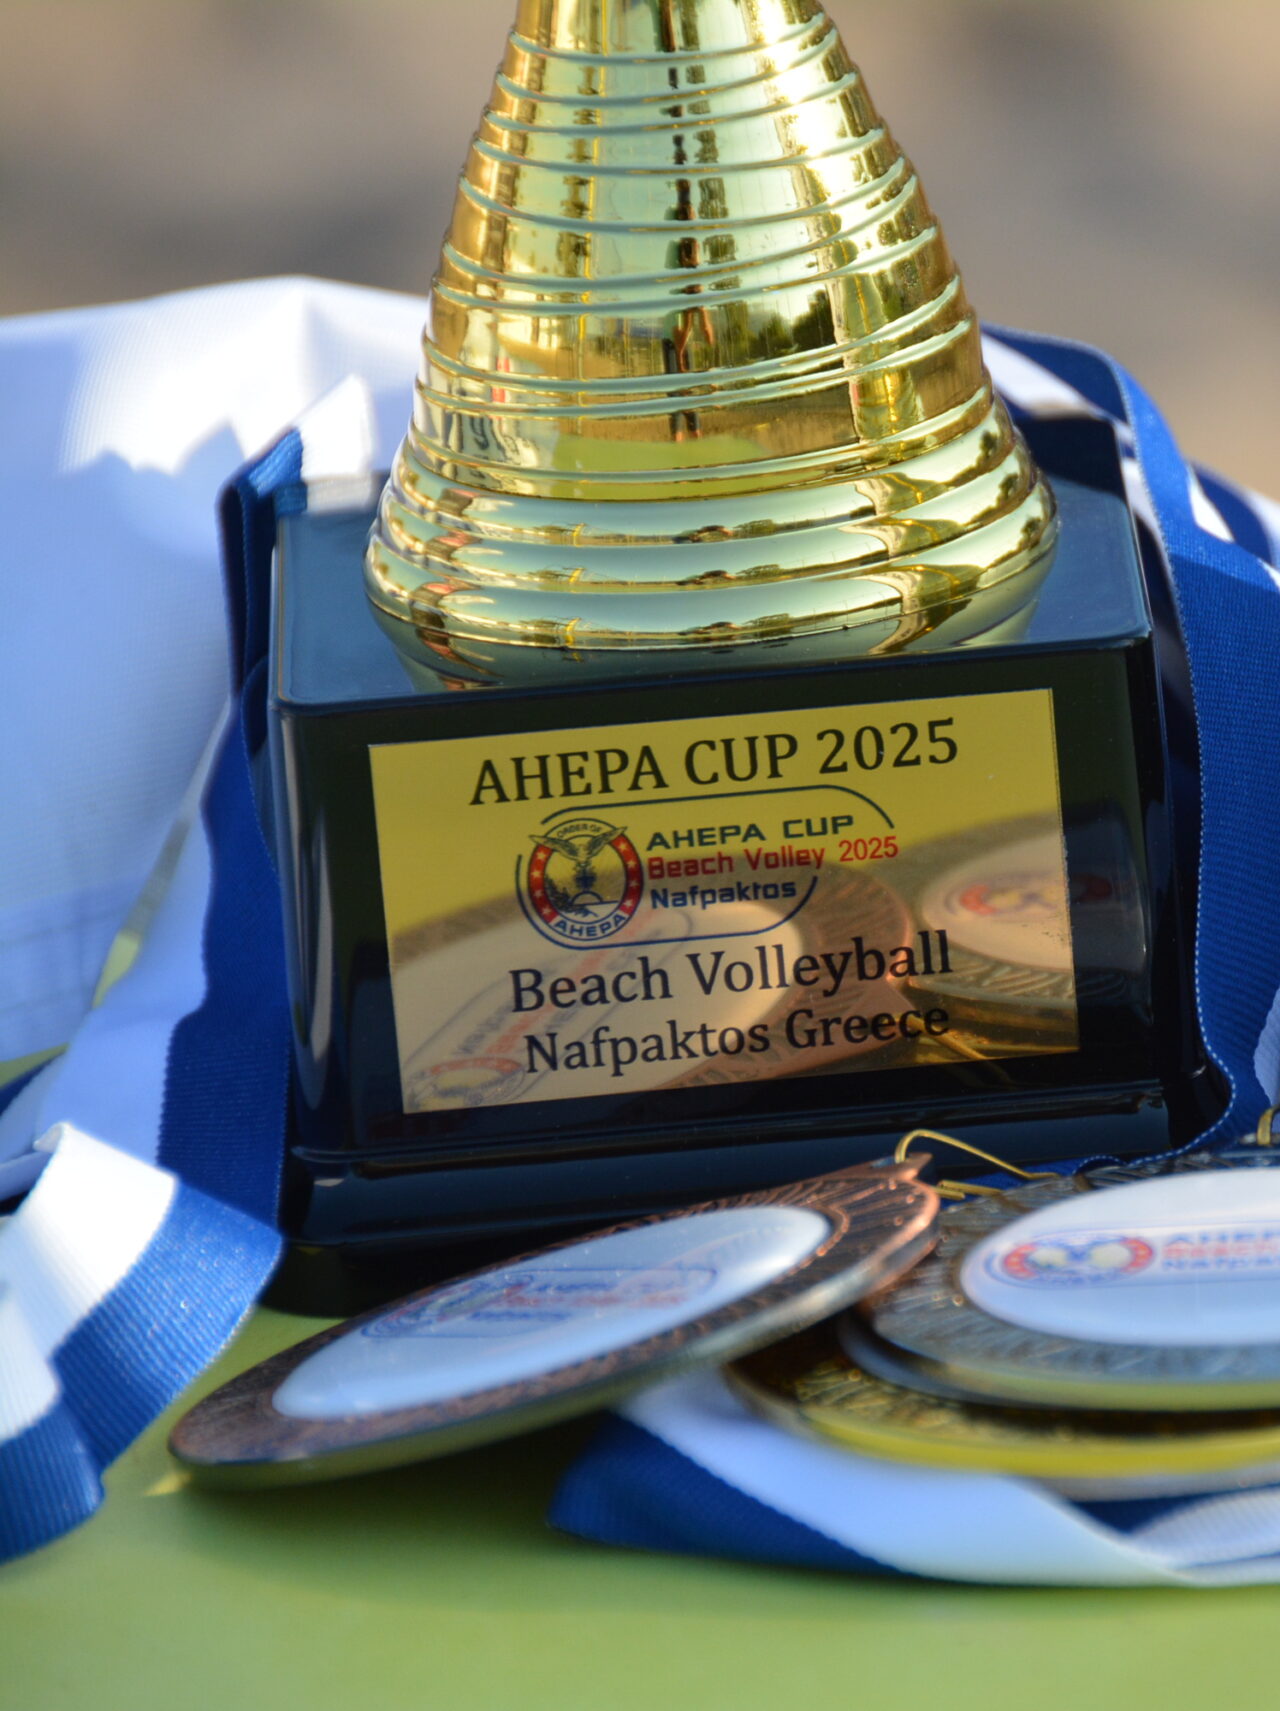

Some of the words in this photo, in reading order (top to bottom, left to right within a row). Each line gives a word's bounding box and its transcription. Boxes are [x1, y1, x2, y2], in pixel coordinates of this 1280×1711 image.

[469, 745, 669, 805] AHEPA
[685, 733, 798, 785] CUP
[818, 718, 958, 775] 2025
[647, 824, 766, 851] AHEPA
[783, 815, 853, 838] CUP
[648, 852, 733, 880] Beach
[744, 845, 825, 869] Volley
[838, 836, 899, 862] 2025
[650, 881, 797, 910] Nafpaktos
[554, 914, 626, 938] AHEPA
[508, 957, 673, 1013] Beach
[688, 929, 955, 997] Volleyball
[524, 1020, 770, 1077] Nafpaktos
[785, 1007, 950, 1049] Greece
